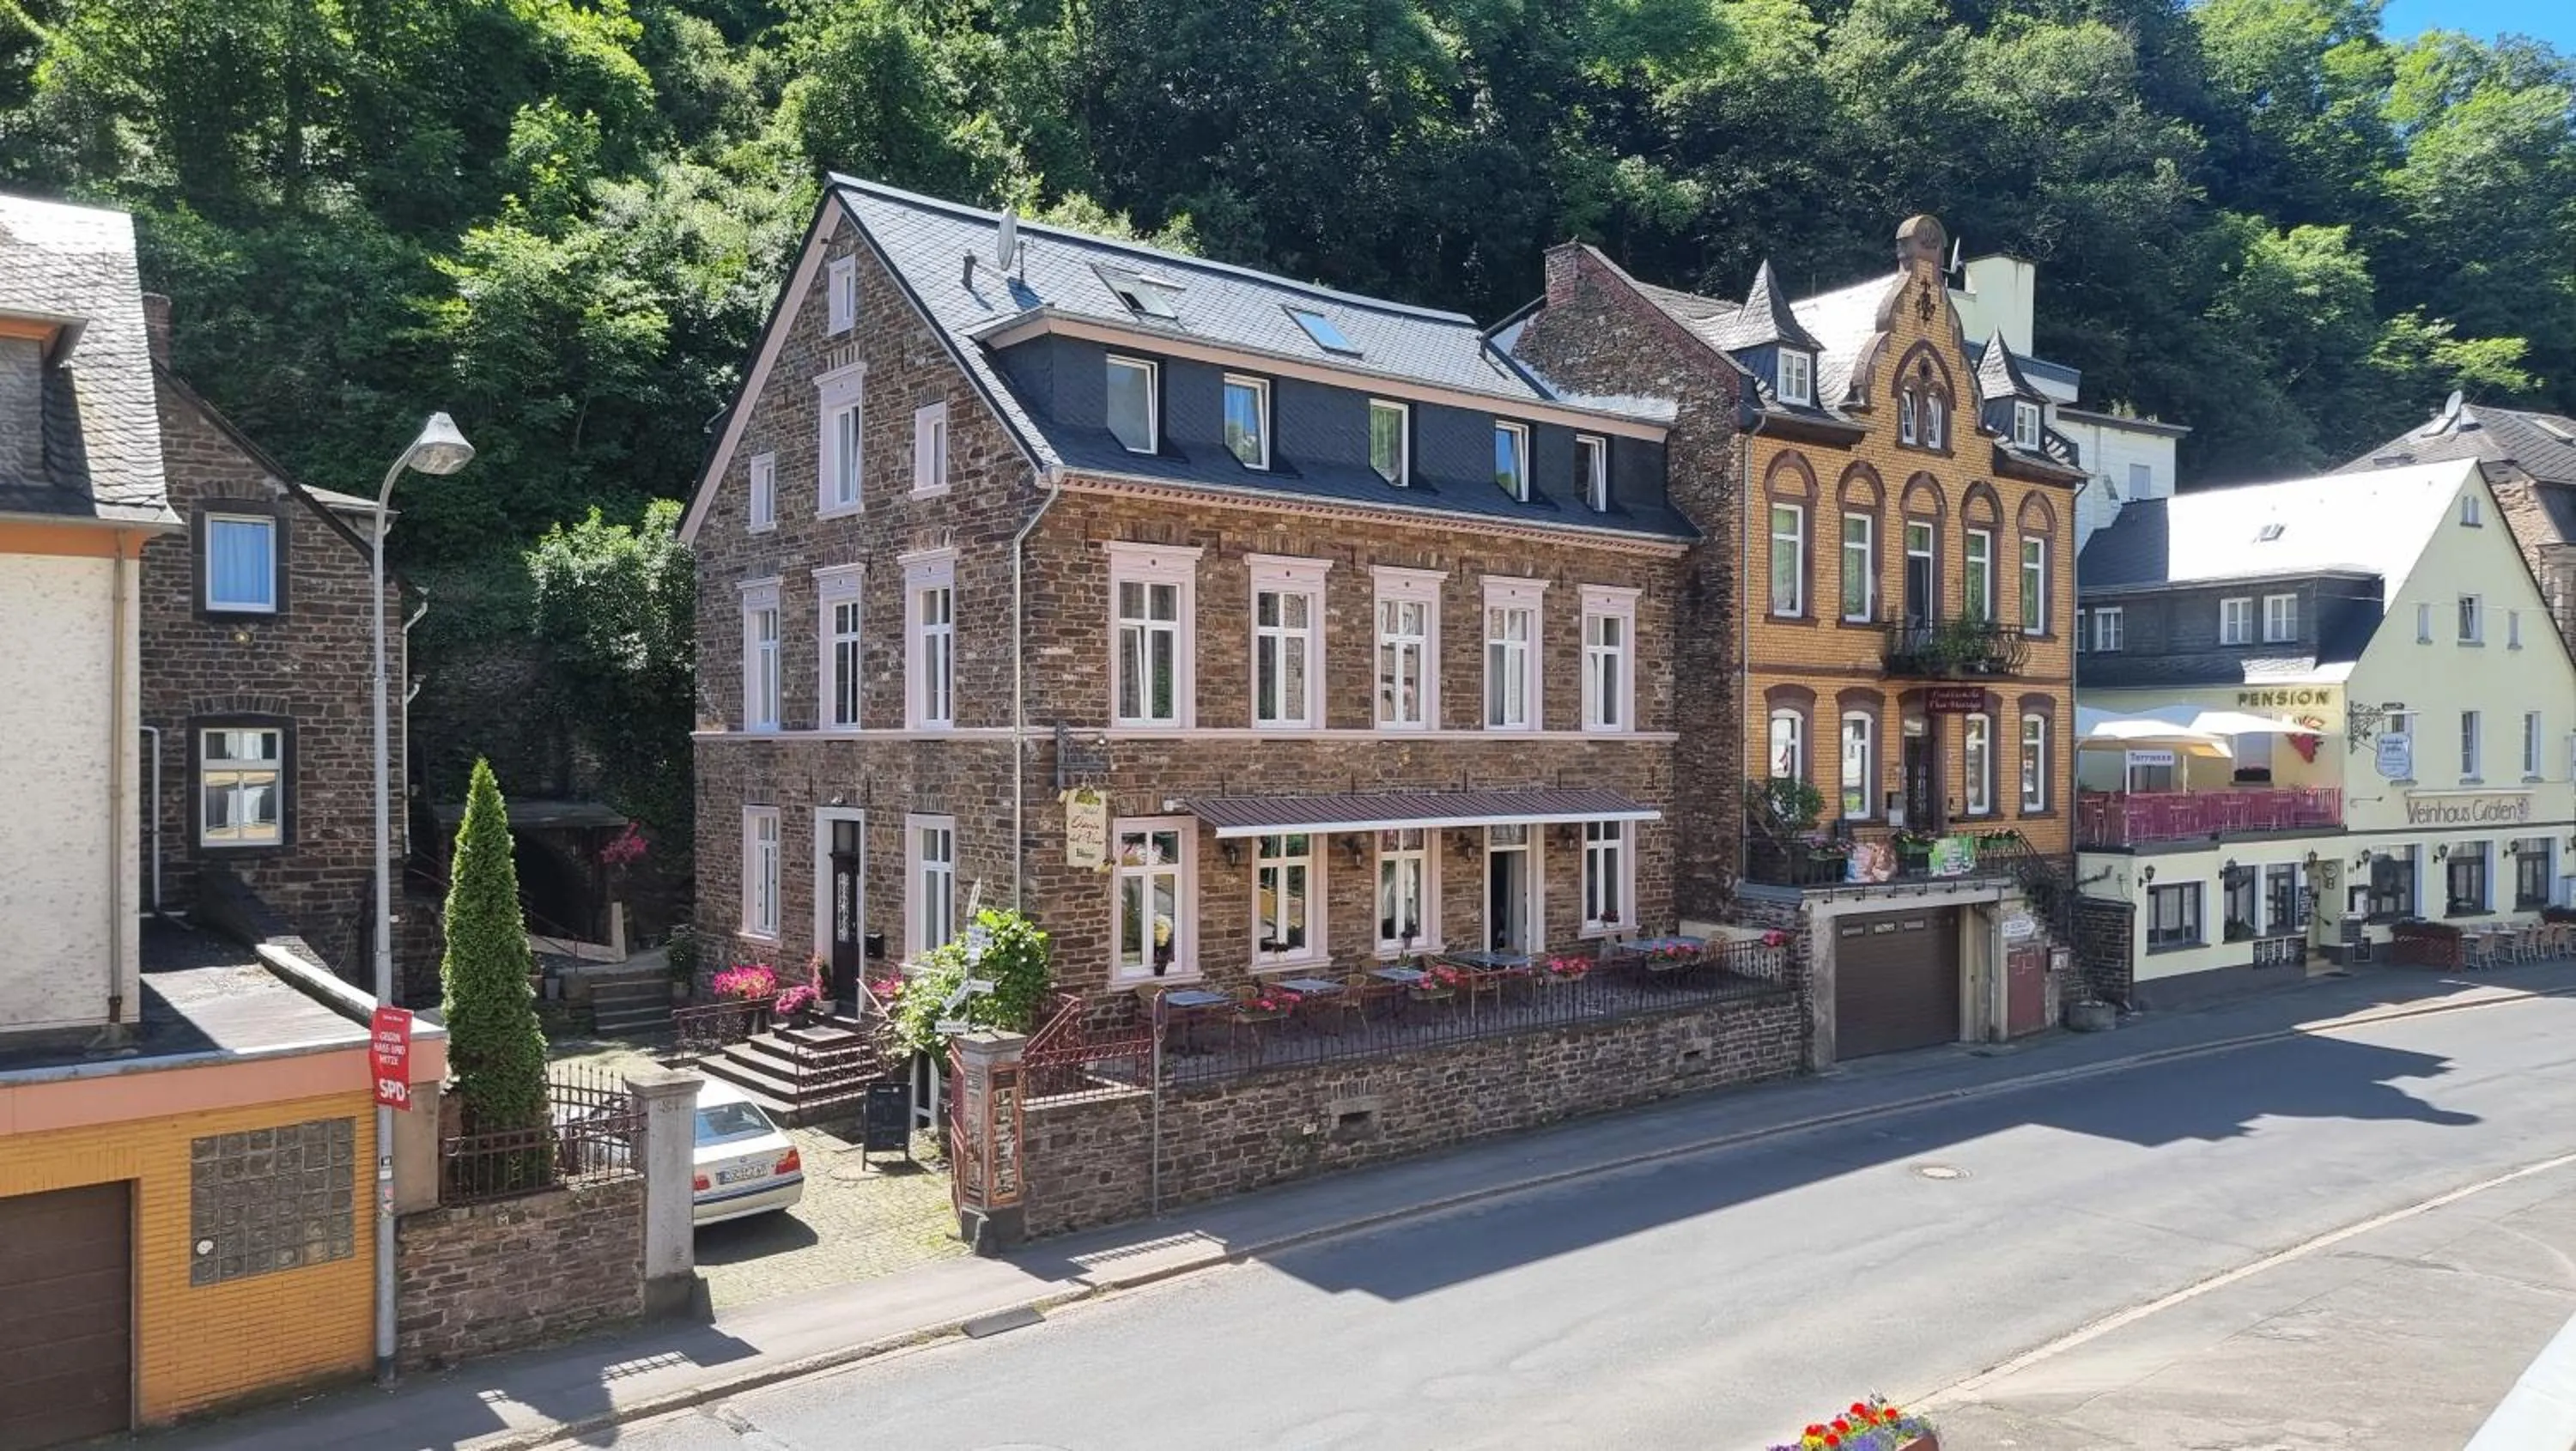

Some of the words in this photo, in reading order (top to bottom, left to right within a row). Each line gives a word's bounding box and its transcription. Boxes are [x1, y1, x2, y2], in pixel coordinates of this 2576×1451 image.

[2238, 690, 2330, 707] PENSION
[2406, 797, 2470, 824] Weinhaus
[379, 1078, 406, 1102] SPD
